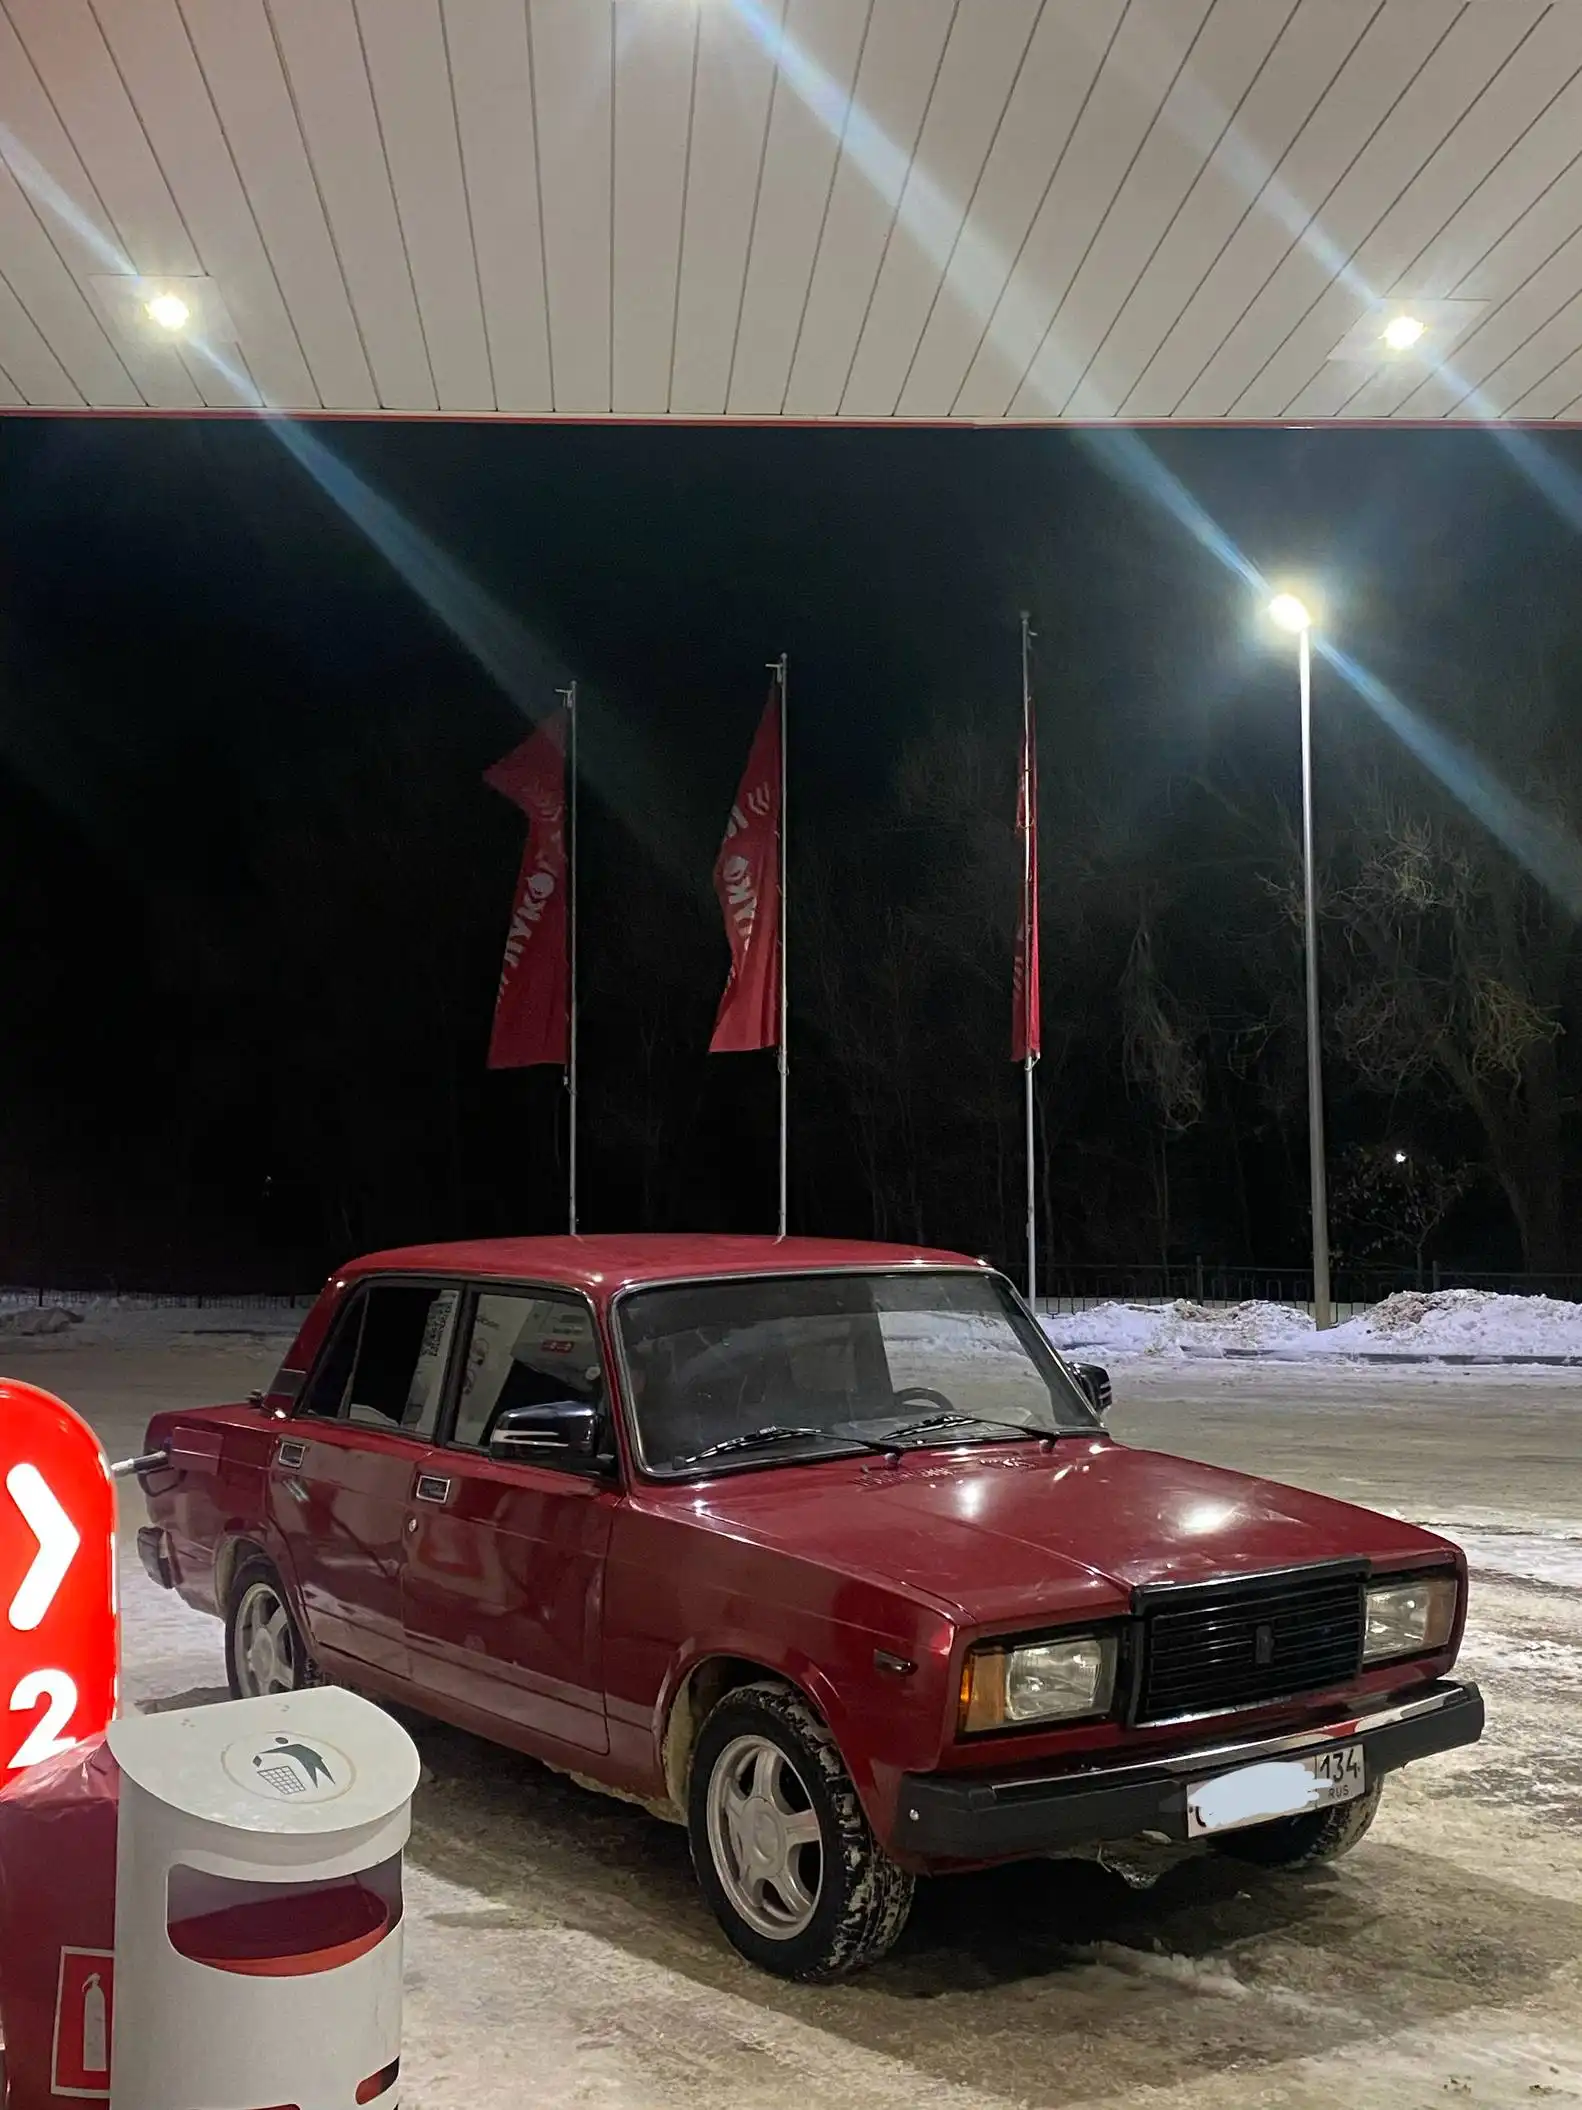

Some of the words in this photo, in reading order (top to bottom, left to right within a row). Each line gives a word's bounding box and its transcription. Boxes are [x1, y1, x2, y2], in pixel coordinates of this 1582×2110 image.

[7, 1668, 78, 1769] 2
[1320, 1748, 1357, 1782] 134
[1328, 1784, 1349, 1798] RUS
